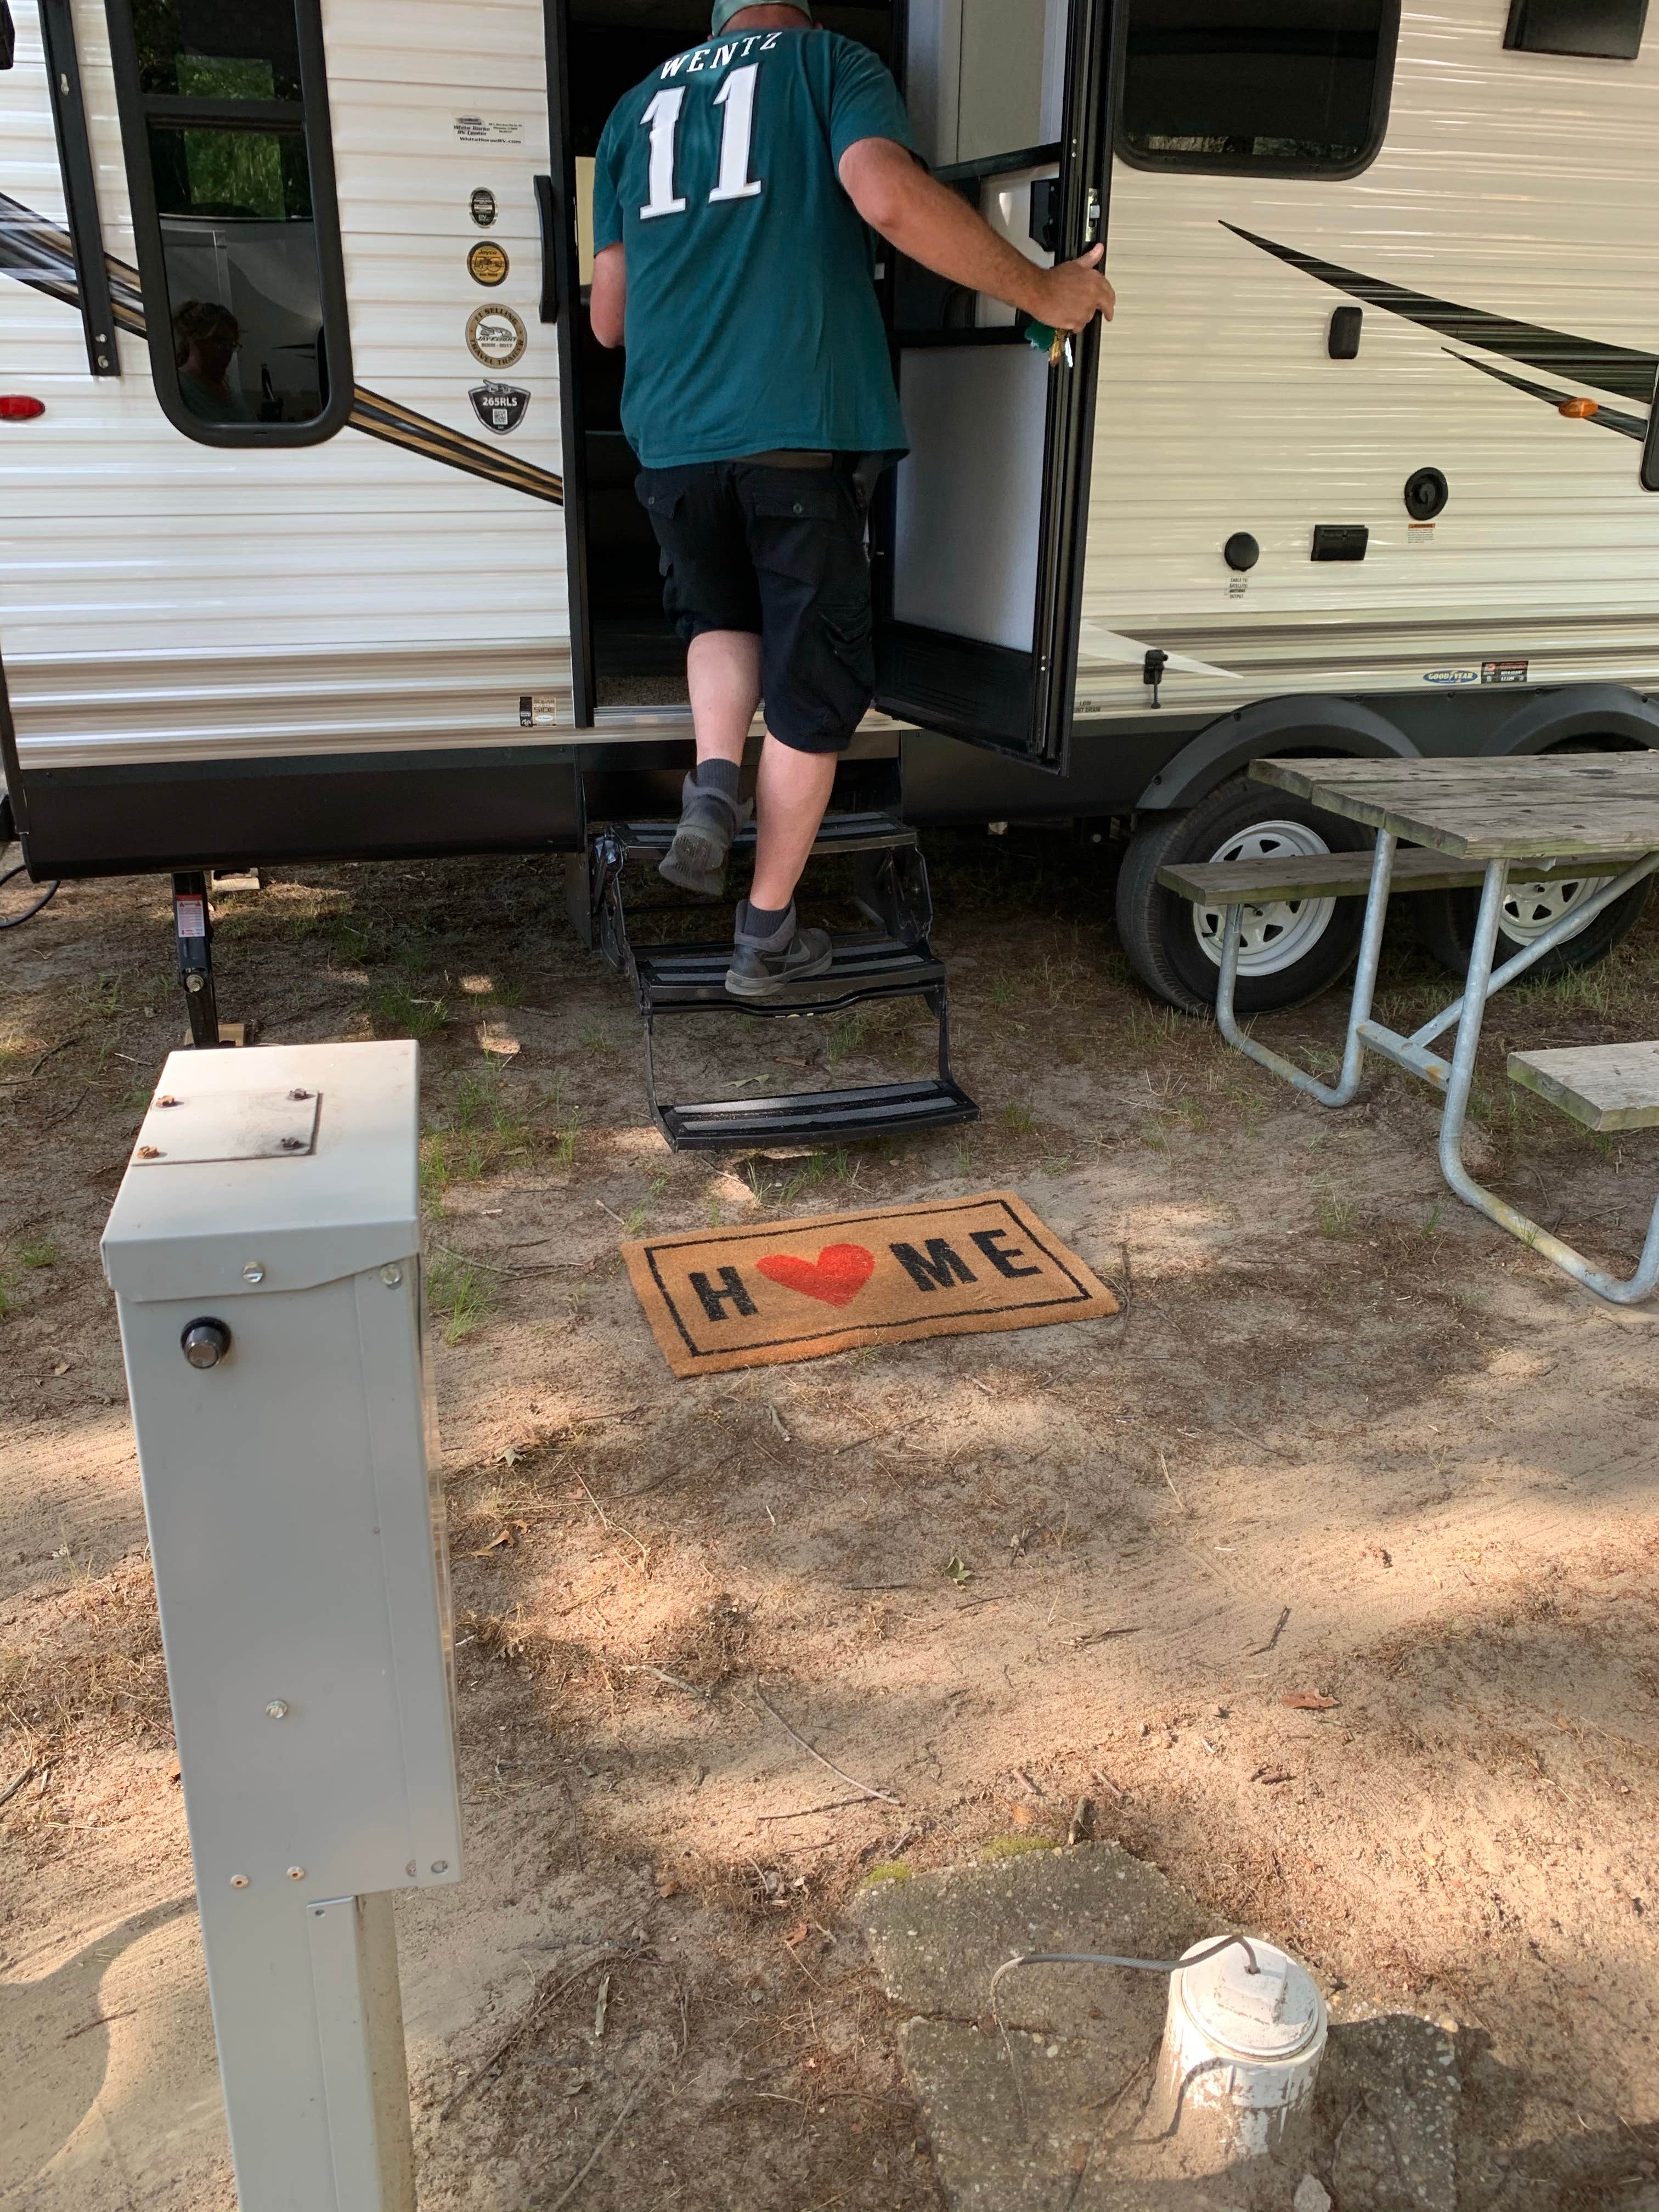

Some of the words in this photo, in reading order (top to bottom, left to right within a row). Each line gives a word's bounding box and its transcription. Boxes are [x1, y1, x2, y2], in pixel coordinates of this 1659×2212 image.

[660, 31, 783, 80] WENTZ
[640, 63, 761, 221] 11
[484, 308, 518, 325] SELLING
[470, 339, 493, 364] TRAVEL
[498, 340, 524, 366] TRAILER
[482, 397, 518, 407] 265RLS
[687, 1266, 758, 1322] H
[889, 1228, 1043, 1293] ME
